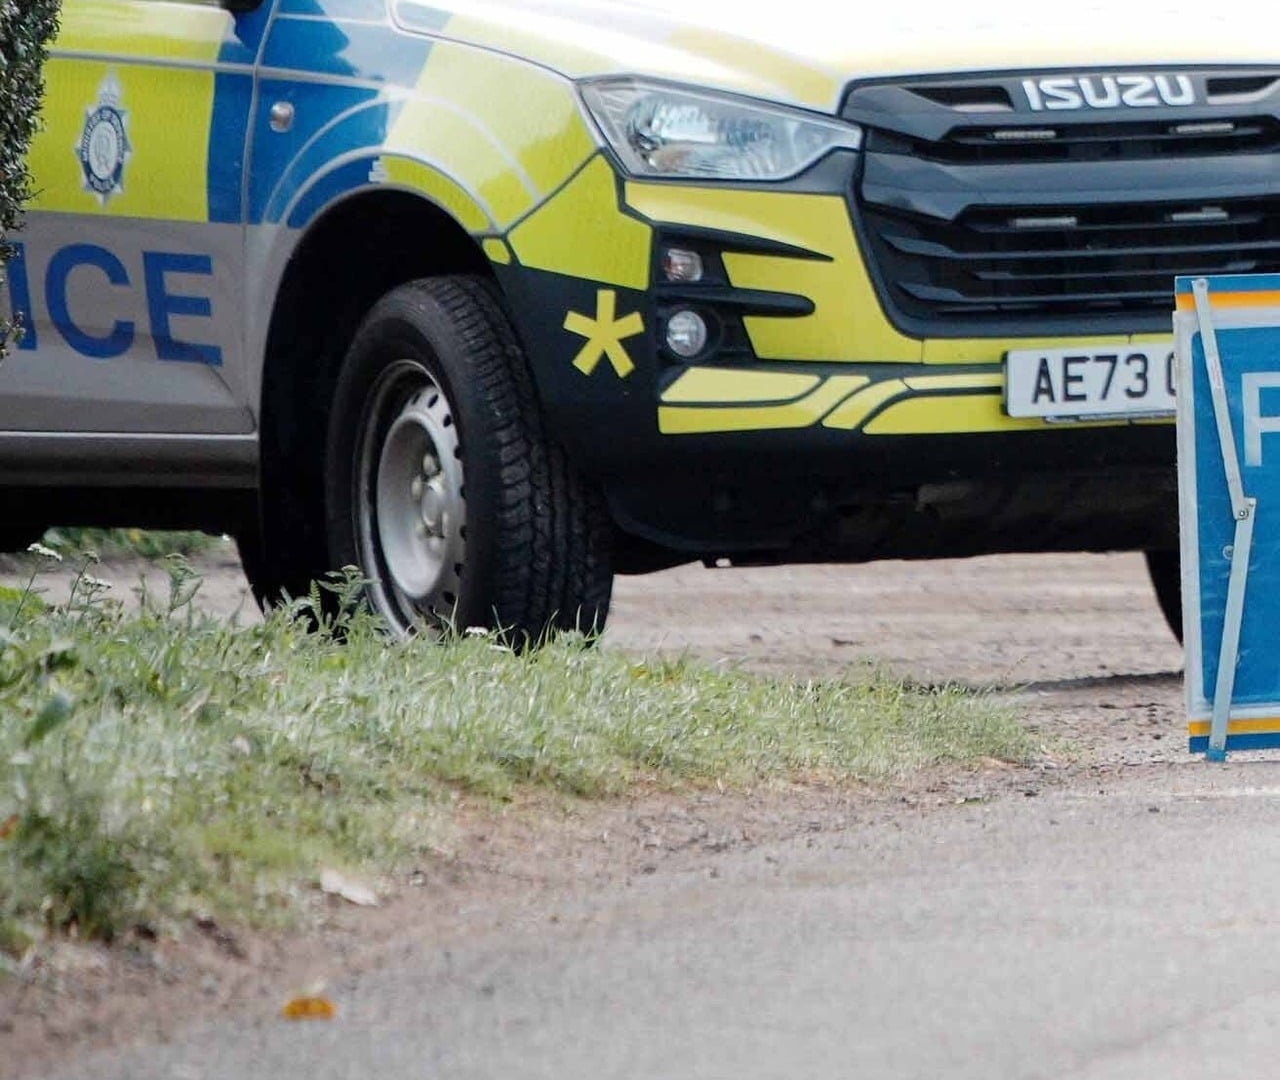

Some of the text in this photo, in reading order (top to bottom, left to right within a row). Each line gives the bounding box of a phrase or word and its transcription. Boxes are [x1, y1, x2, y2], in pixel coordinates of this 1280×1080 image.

[1022, 75, 1195, 111] ISUZU
[3, 241, 223, 367] ICE
[1032, 353, 1149, 404] AE73
